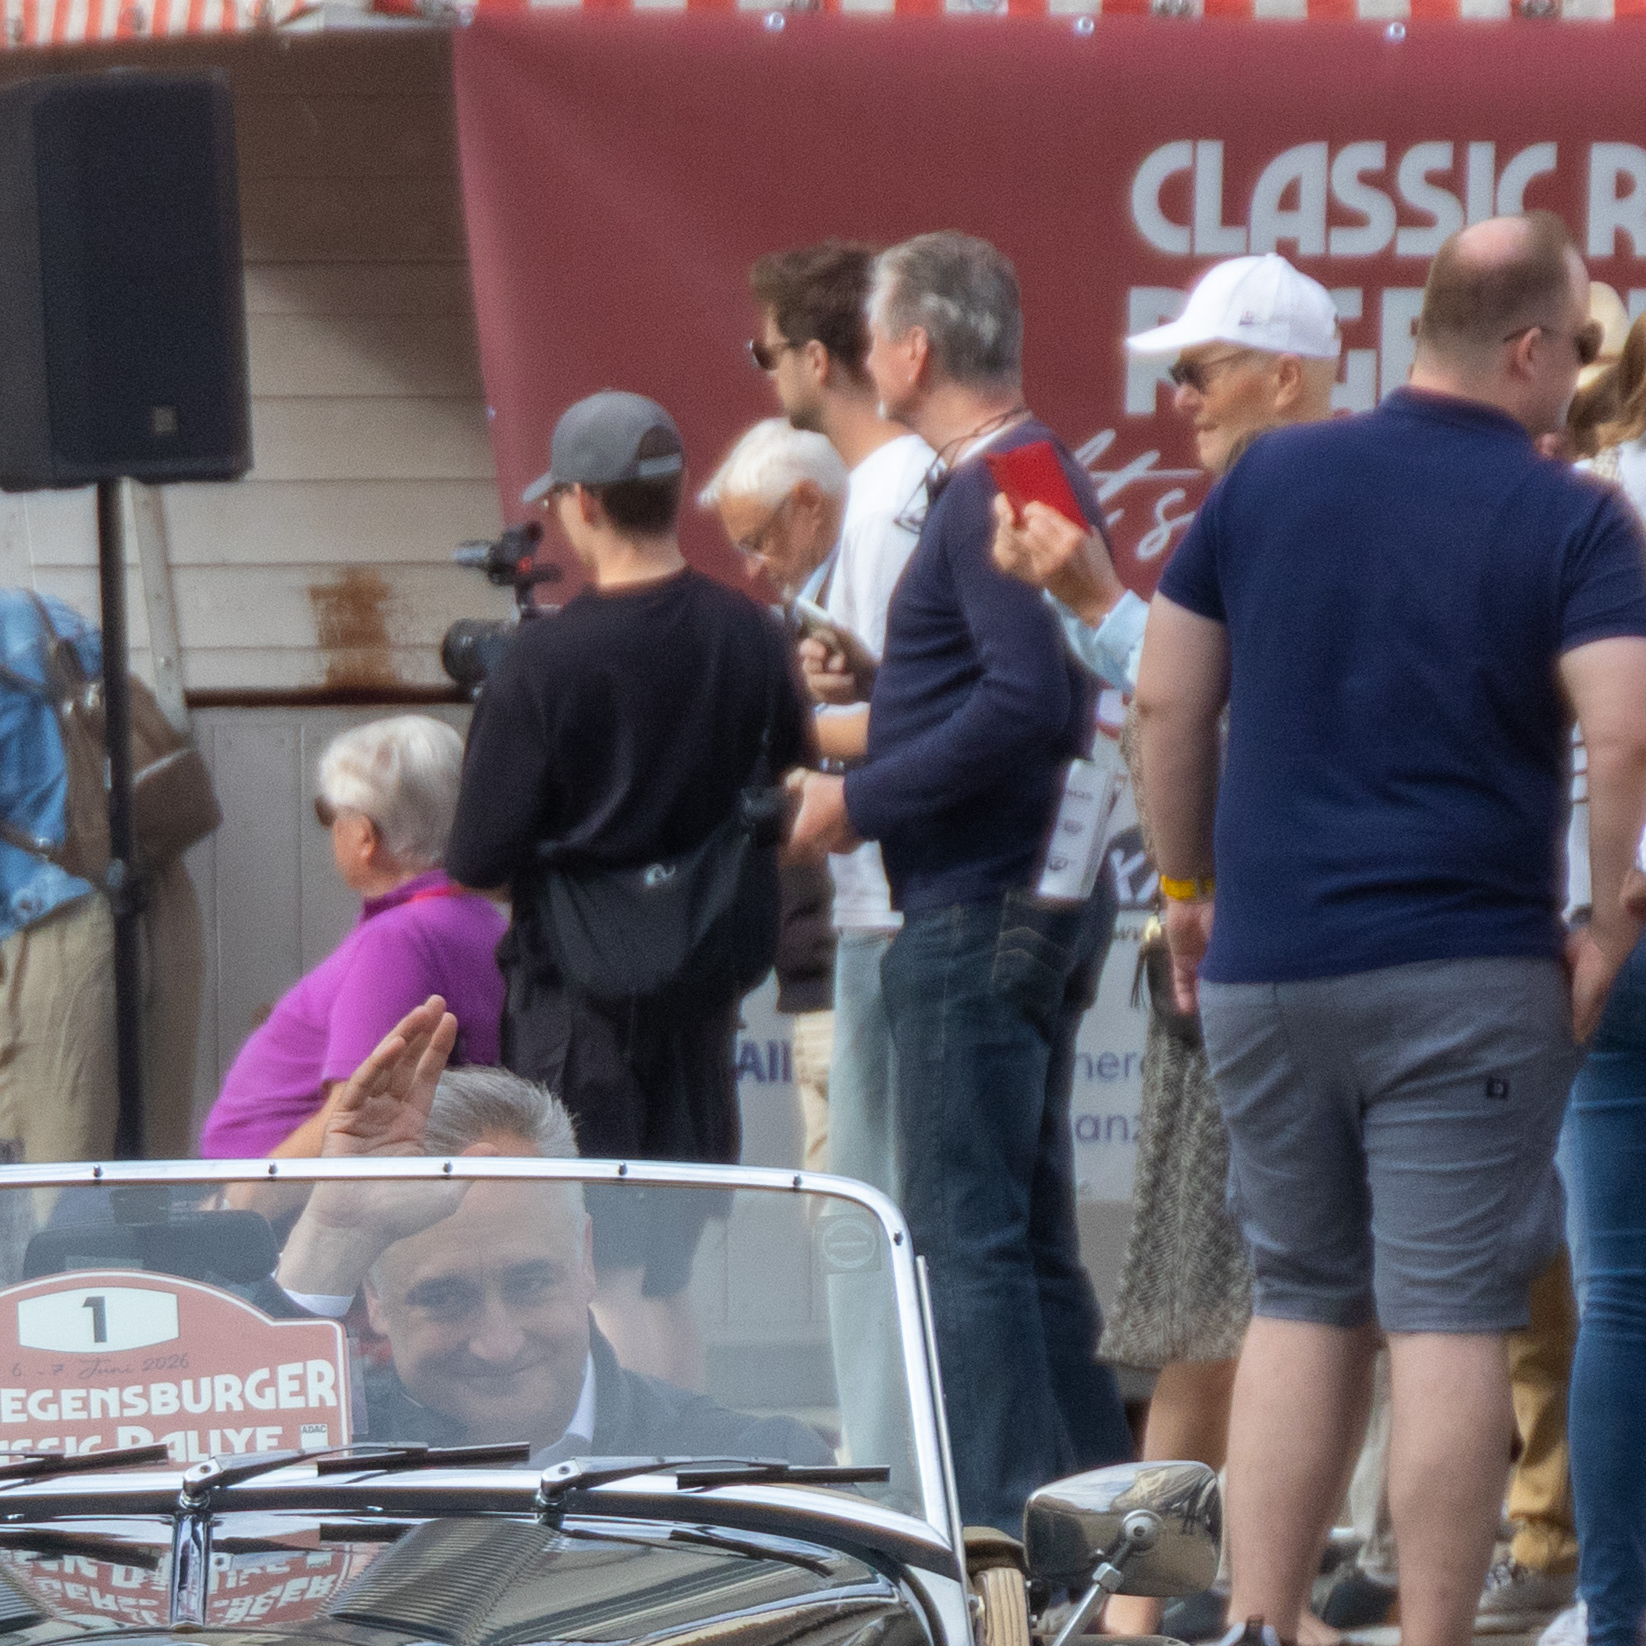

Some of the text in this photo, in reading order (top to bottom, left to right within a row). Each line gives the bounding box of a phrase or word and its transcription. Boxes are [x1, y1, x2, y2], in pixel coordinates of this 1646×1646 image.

[1130, 140, 1557, 258] CLASSIC
[82, 1296, 108, 1344] 1
[142, 1353, 190, 1372] 2026
[302, 1424, 328, 1434] ADAC
